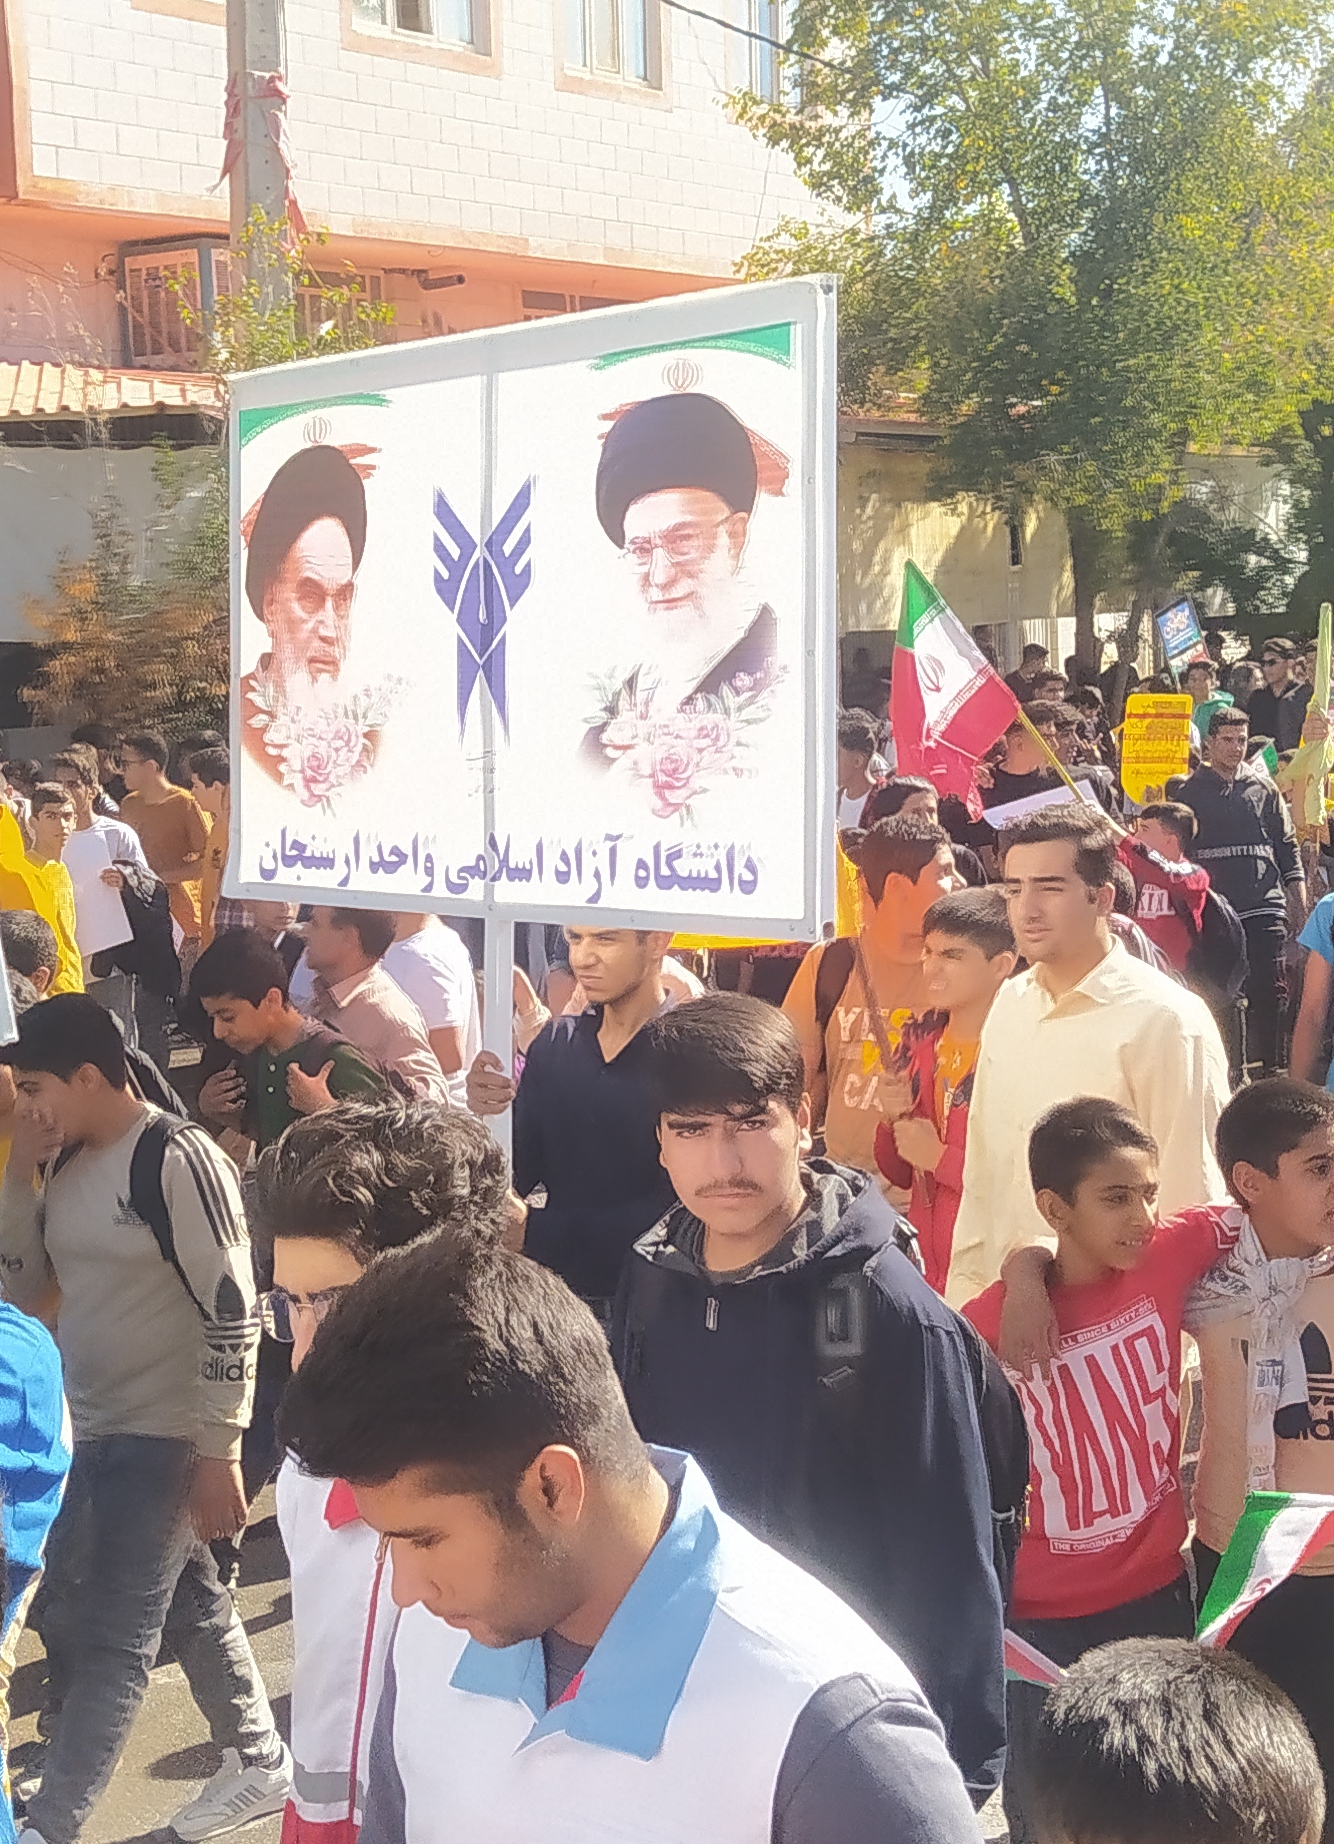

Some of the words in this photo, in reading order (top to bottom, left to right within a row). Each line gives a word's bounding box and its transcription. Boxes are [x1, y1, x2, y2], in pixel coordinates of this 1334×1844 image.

[258, 825, 361, 888] ارسنجان
[367, 831, 436, 894] واحد
[444, 831, 544, 895] اسلامی
[554, 833, 622, 904] آزاد
[632, 839, 760, 896] دانشگاه
[1076, 1325, 1108, 1343] SINCE
